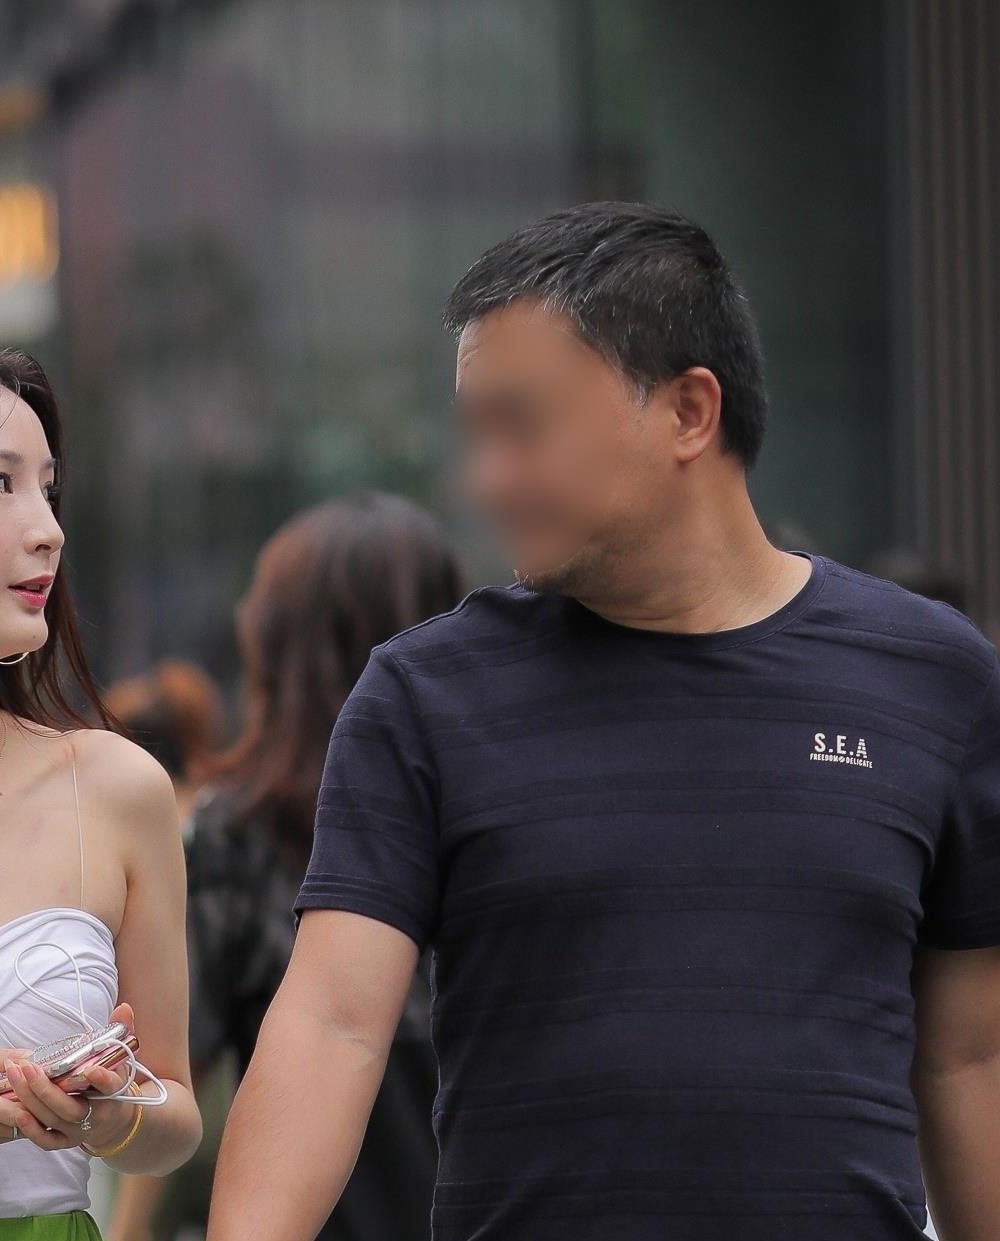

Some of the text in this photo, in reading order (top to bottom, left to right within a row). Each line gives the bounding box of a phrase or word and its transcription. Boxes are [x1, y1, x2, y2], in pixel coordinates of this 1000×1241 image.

[814, 732, 868, 759] S.E.A
[809, 753, 873, 768] FREEDOM DELICATE
